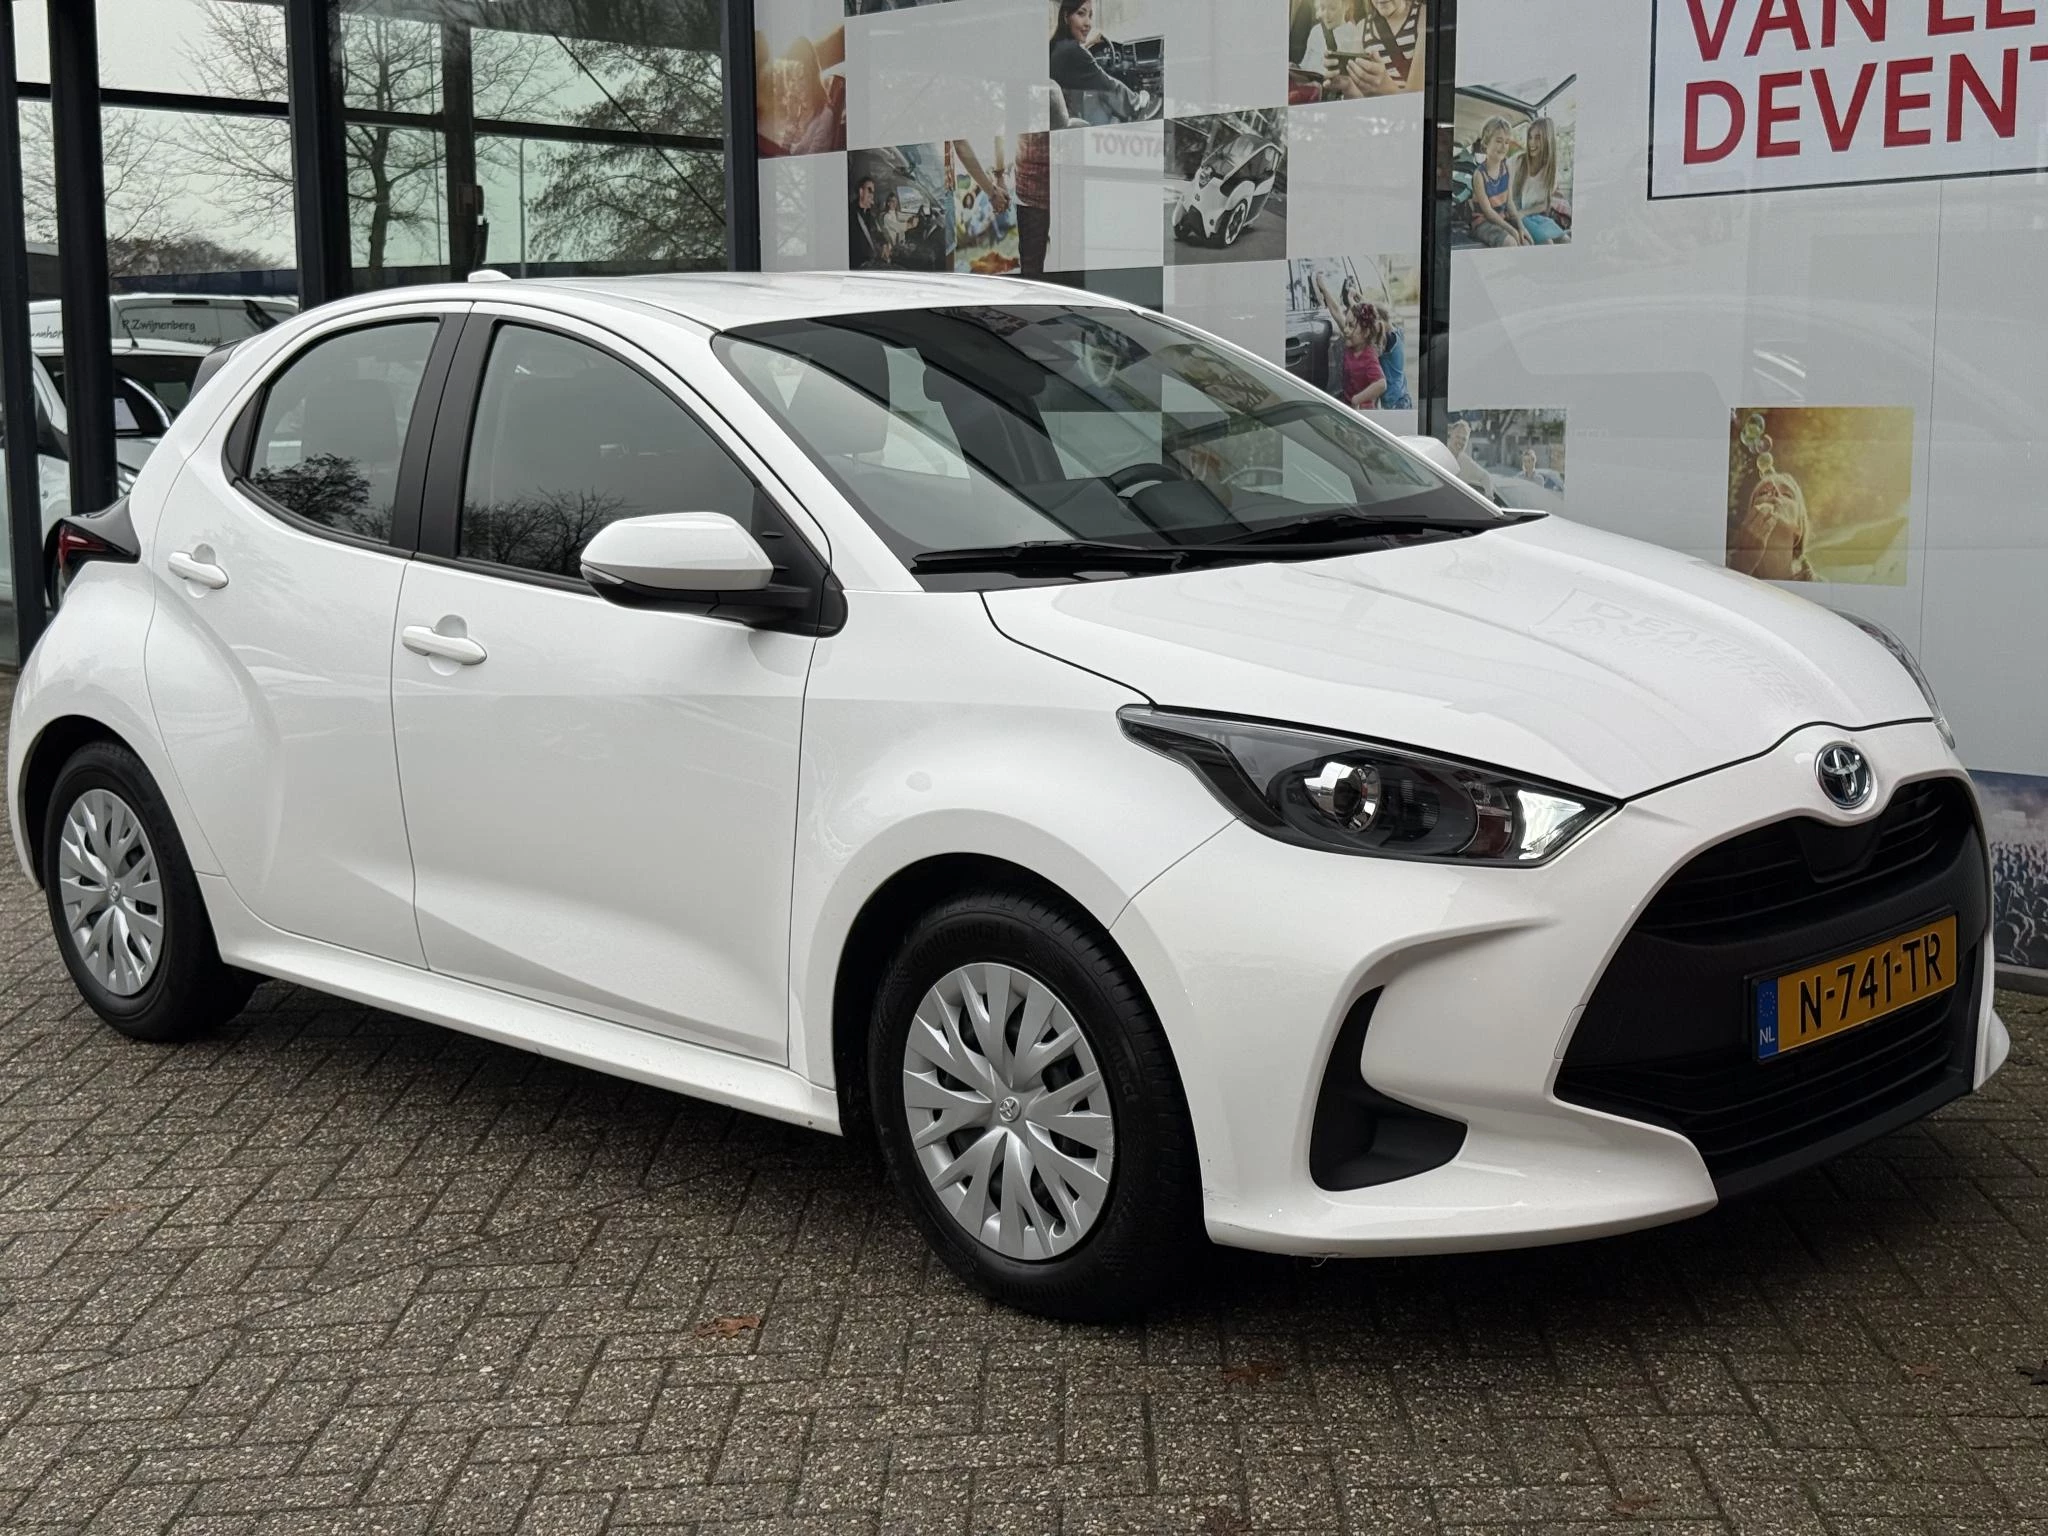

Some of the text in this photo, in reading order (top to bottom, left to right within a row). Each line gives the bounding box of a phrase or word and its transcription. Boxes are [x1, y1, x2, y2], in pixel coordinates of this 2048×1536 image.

[1687, 0, 1887, 62] VAN
[1799, 931, 1943, 1035] N-741-TR
[1759, 1025, 1776, 1046] NL
